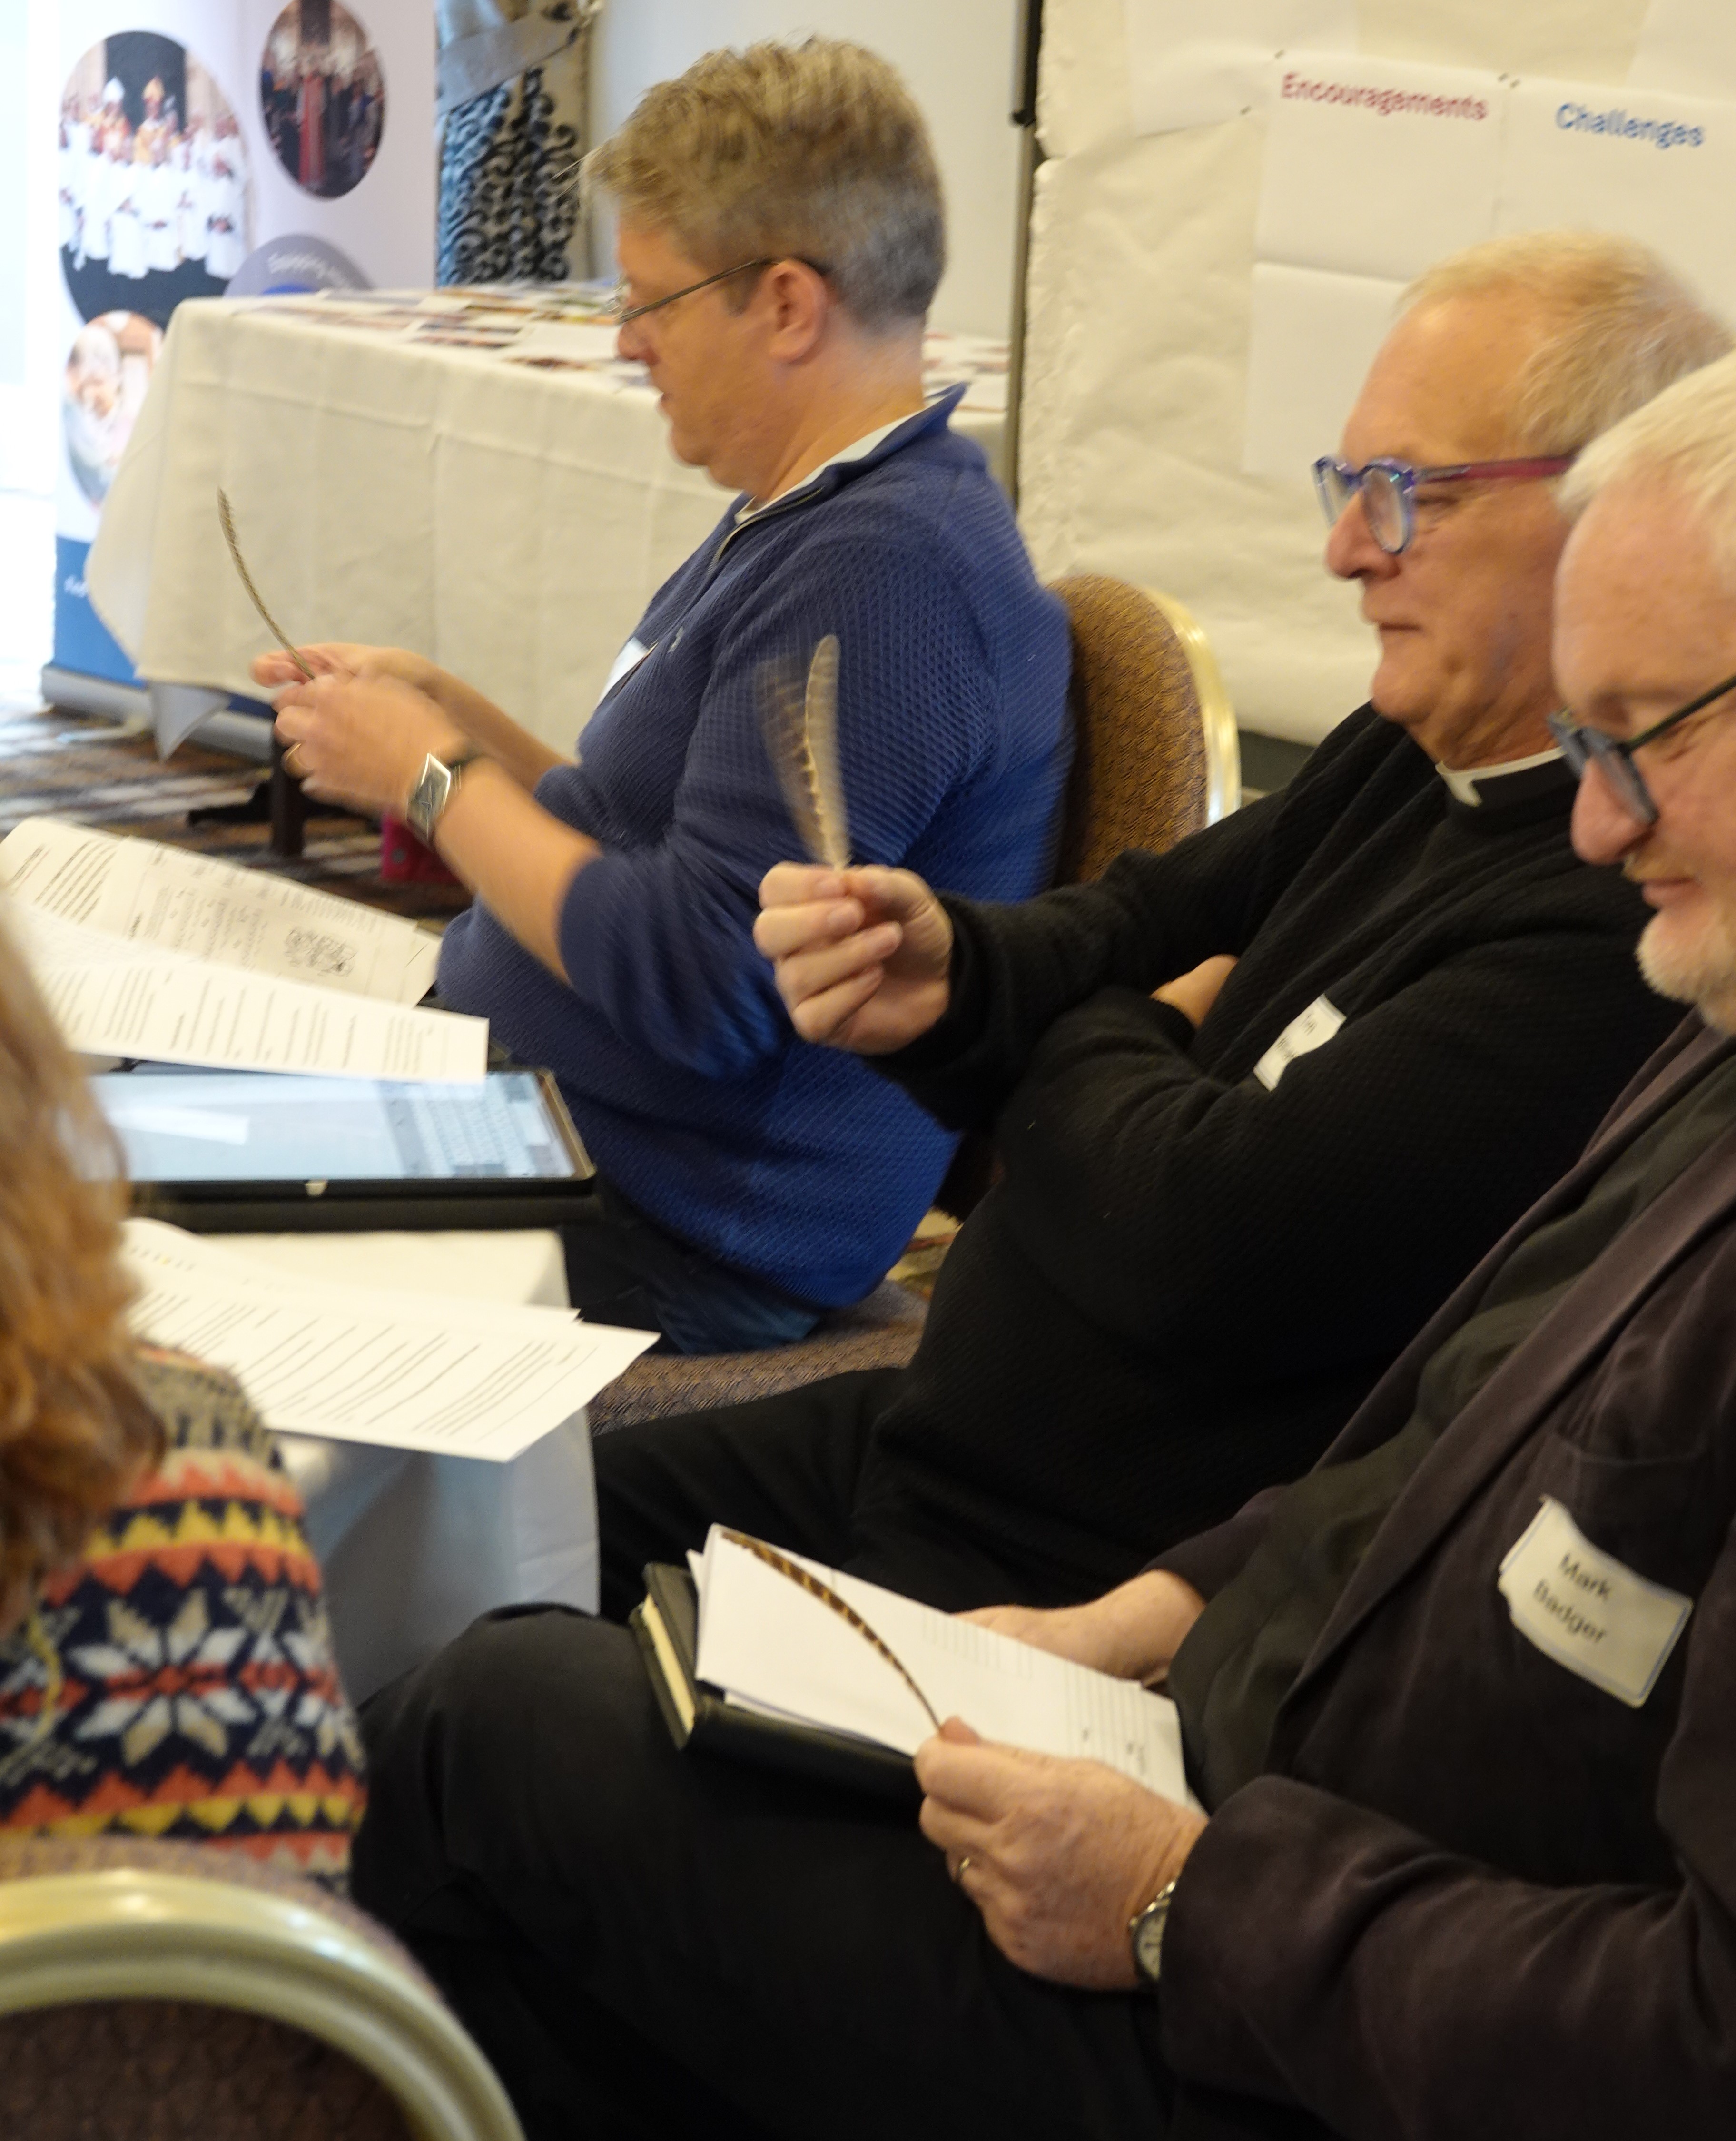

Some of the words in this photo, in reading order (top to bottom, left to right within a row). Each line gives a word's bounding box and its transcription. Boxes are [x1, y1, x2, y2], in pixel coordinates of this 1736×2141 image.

[1282, 72, 1487, 121] Encouragements
[1556, 102, 1704, 149] Challenges
[1561, 1554, 1611, 1600] Mark
